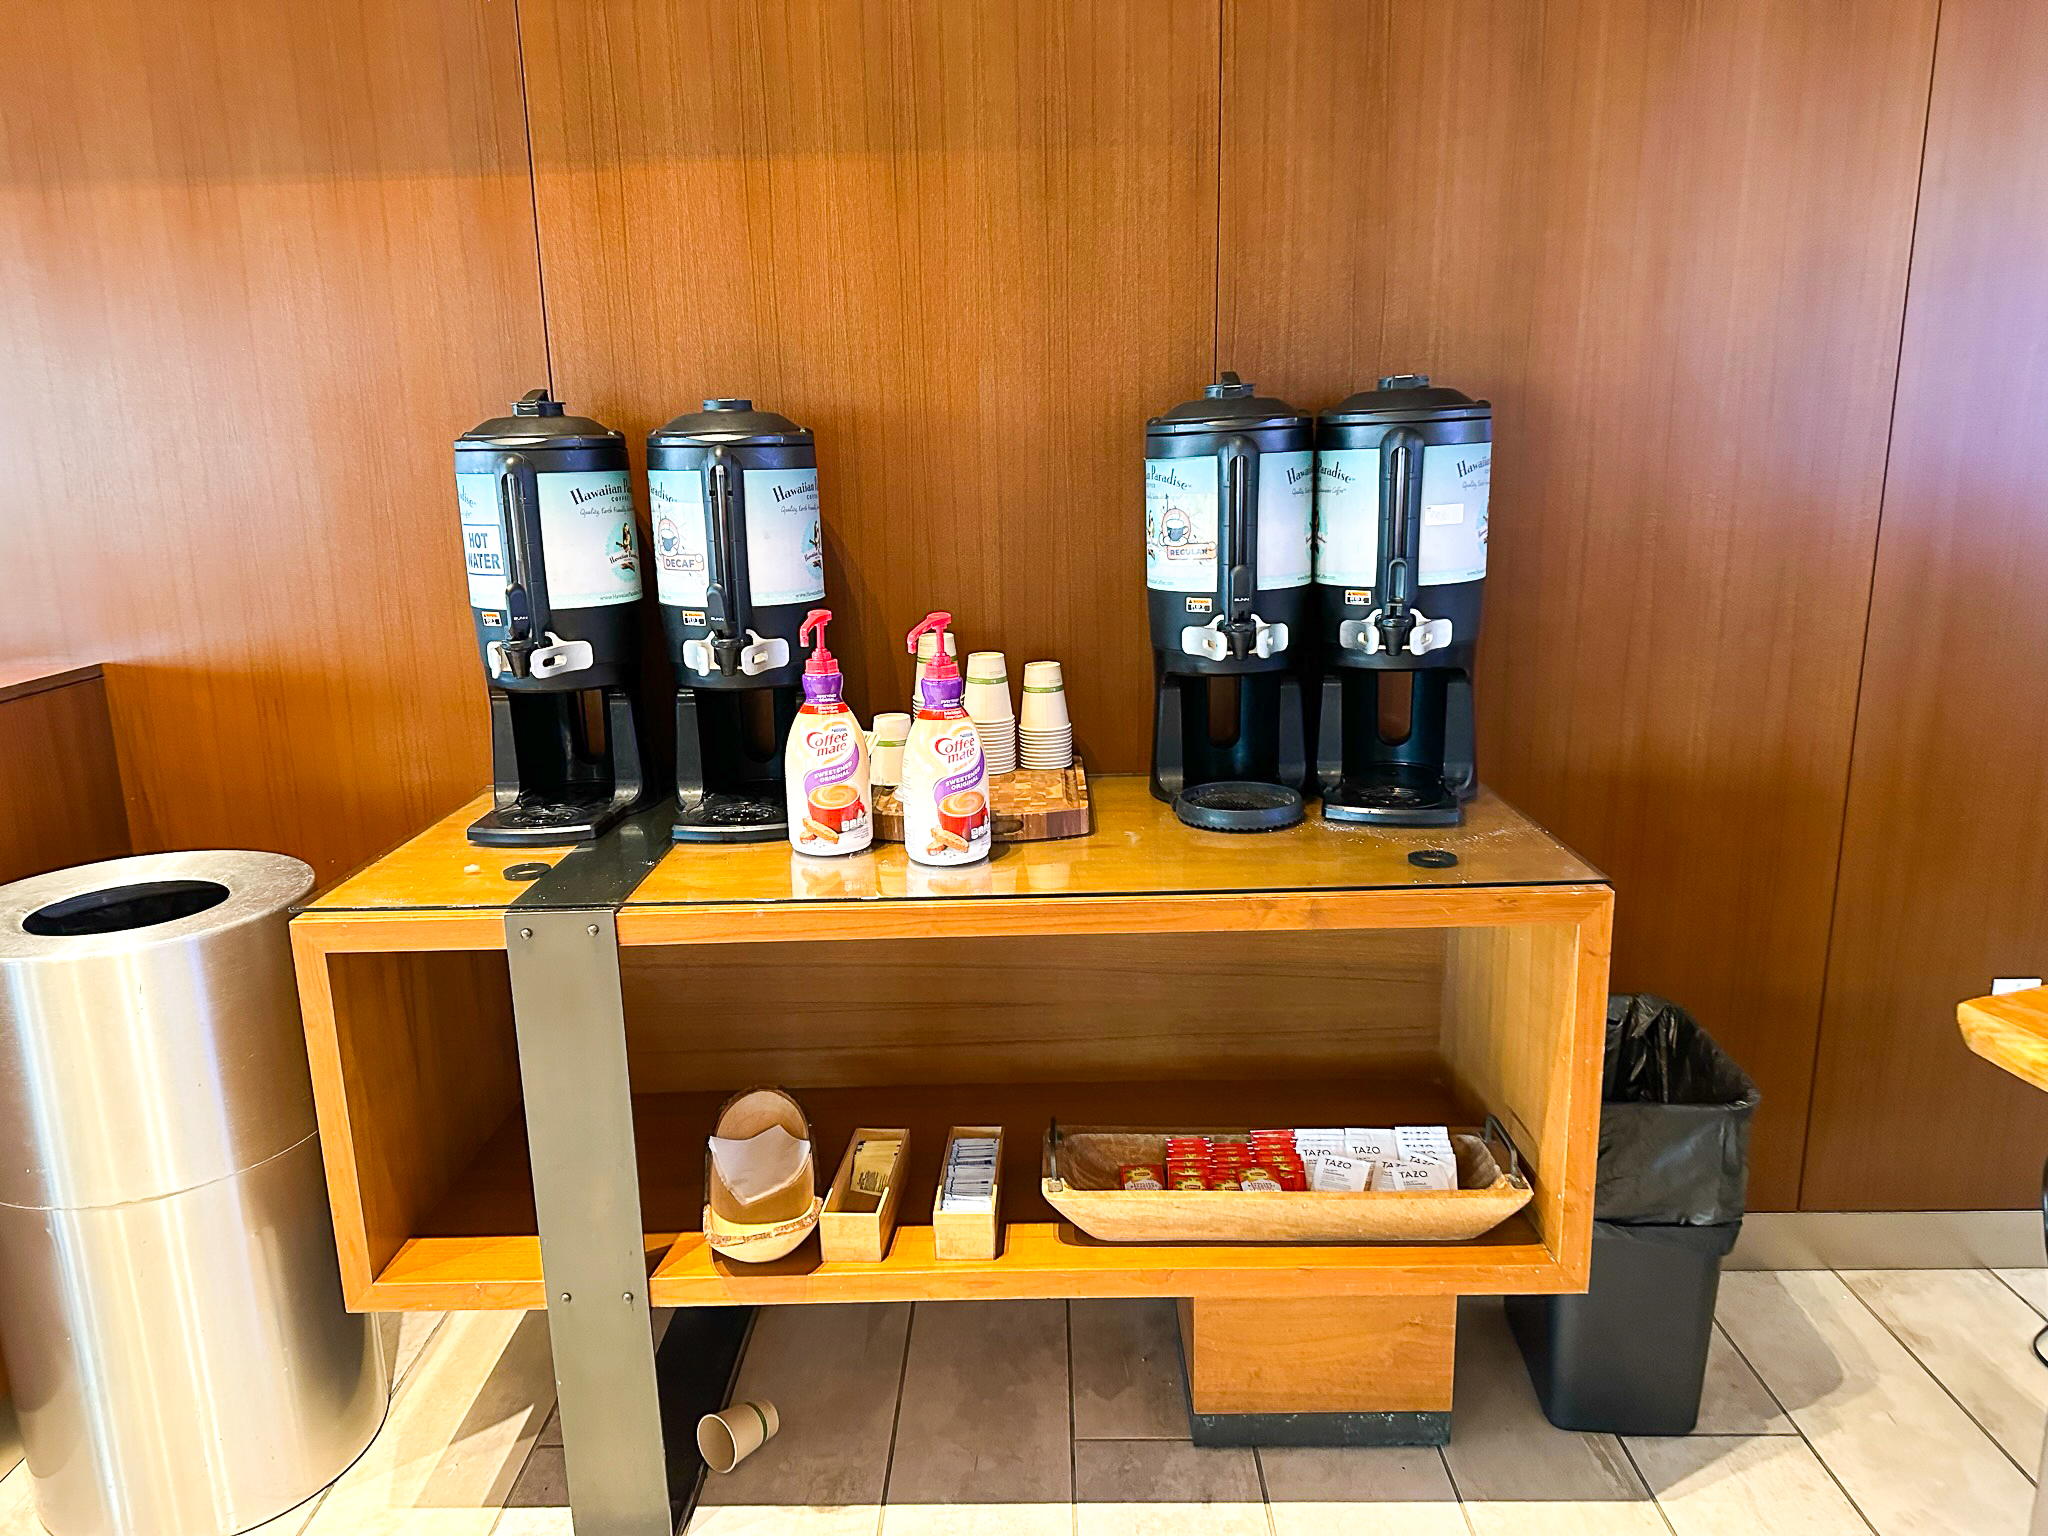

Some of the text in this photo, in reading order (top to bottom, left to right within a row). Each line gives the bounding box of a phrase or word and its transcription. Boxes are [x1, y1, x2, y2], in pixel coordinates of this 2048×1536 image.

[1151, 464, 1188, 490] Paradise
[570, 483, 622, 505] Hawaiian
[772, 481, 814, 502] Hawaiian
[468, 532, 488, 549] HOT
[1169, 548, 1208, 556] REGULAR
[665, 558, 695, 569] DECAF
[806, 731, 848, 750] Coffee
[934, 737, 975, 756] Coffee
[817, 742, 847, 757] mate
[947, 747, 975, 763] mate
[814, 760, 853, 779] SWEETENED
[819, 769, 850, 782] ORIGINAL
[945, 765, 981, 787] SWEETENED
[951, 776, 979, 790] ORIGINAL
[1352, 1146, 1381, 1155] TAZO
[1325, 1158, 1352, 1169] TAZO
[1399, 1170, 1428, 1178] TAZO
